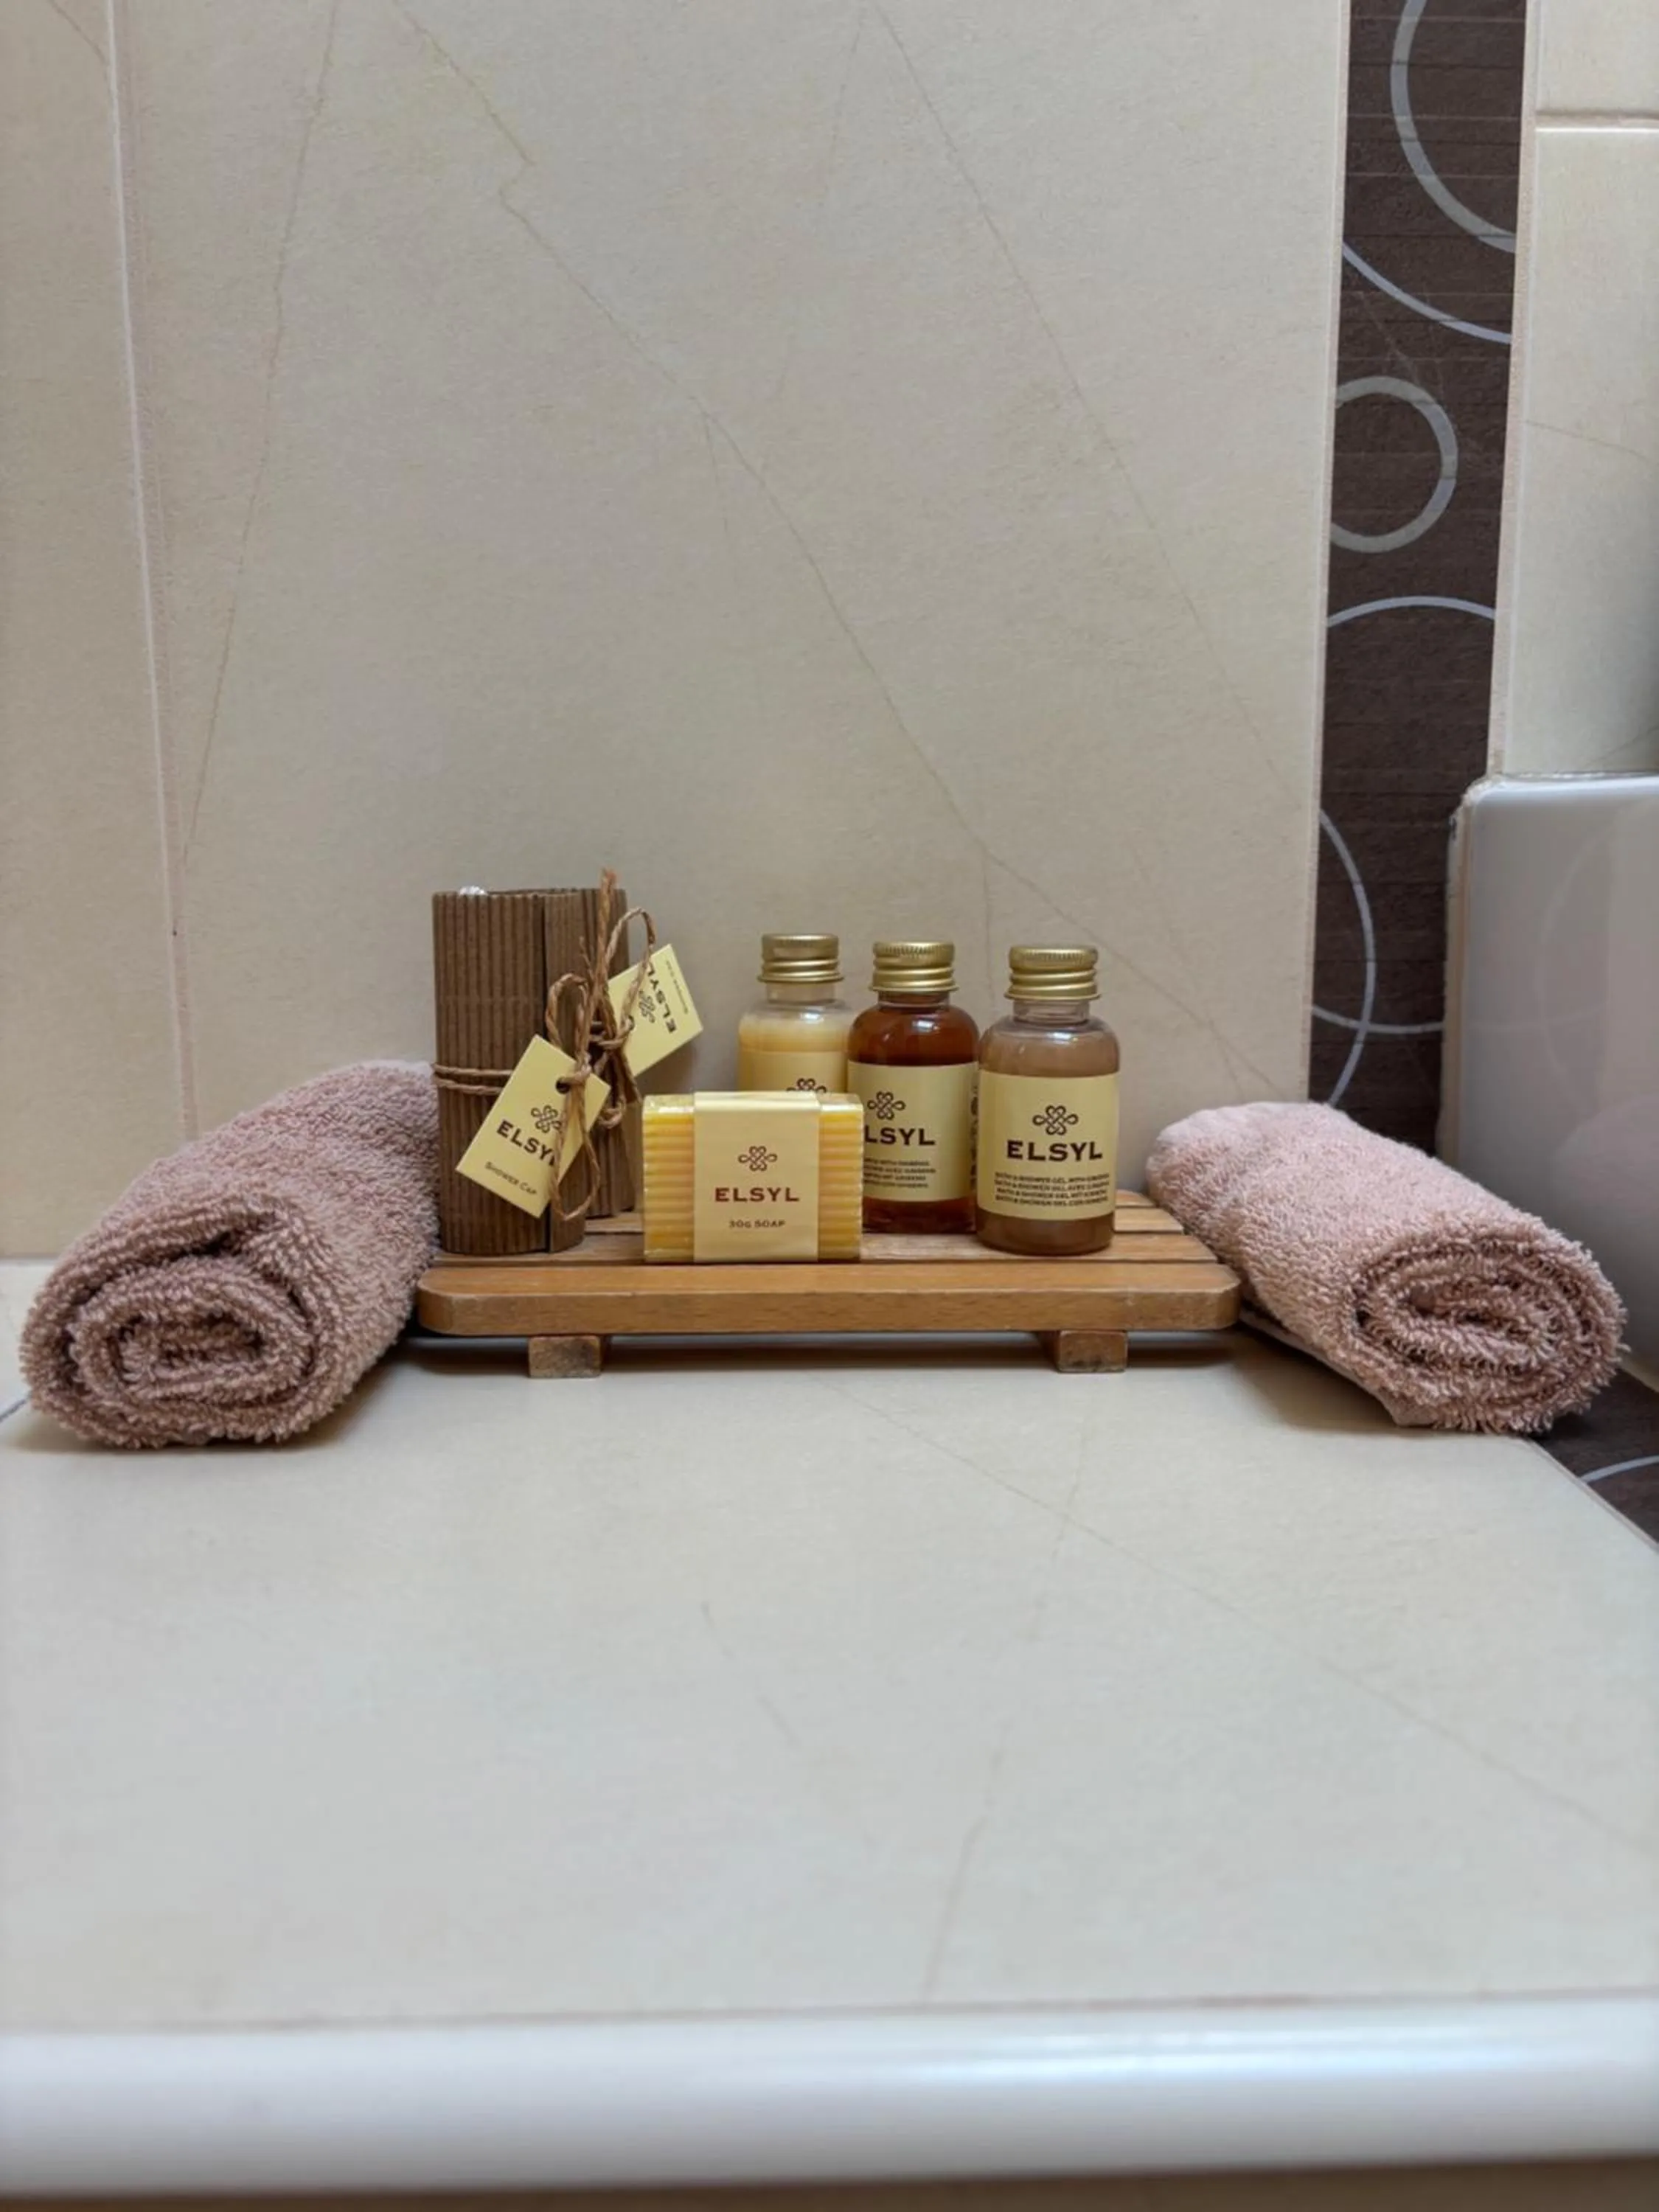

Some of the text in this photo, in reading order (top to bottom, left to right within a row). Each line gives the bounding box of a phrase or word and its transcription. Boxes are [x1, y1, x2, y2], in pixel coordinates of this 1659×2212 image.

[647, 961, 677, 1034] ELSYL
[863, 1125, 936, 1146] LSYL
[1007, 1140, 1103, 1162] ELSYL
[714, 1187, 800, 1203] ELSYL
[754, 1219, 786, 1228] SOAP
